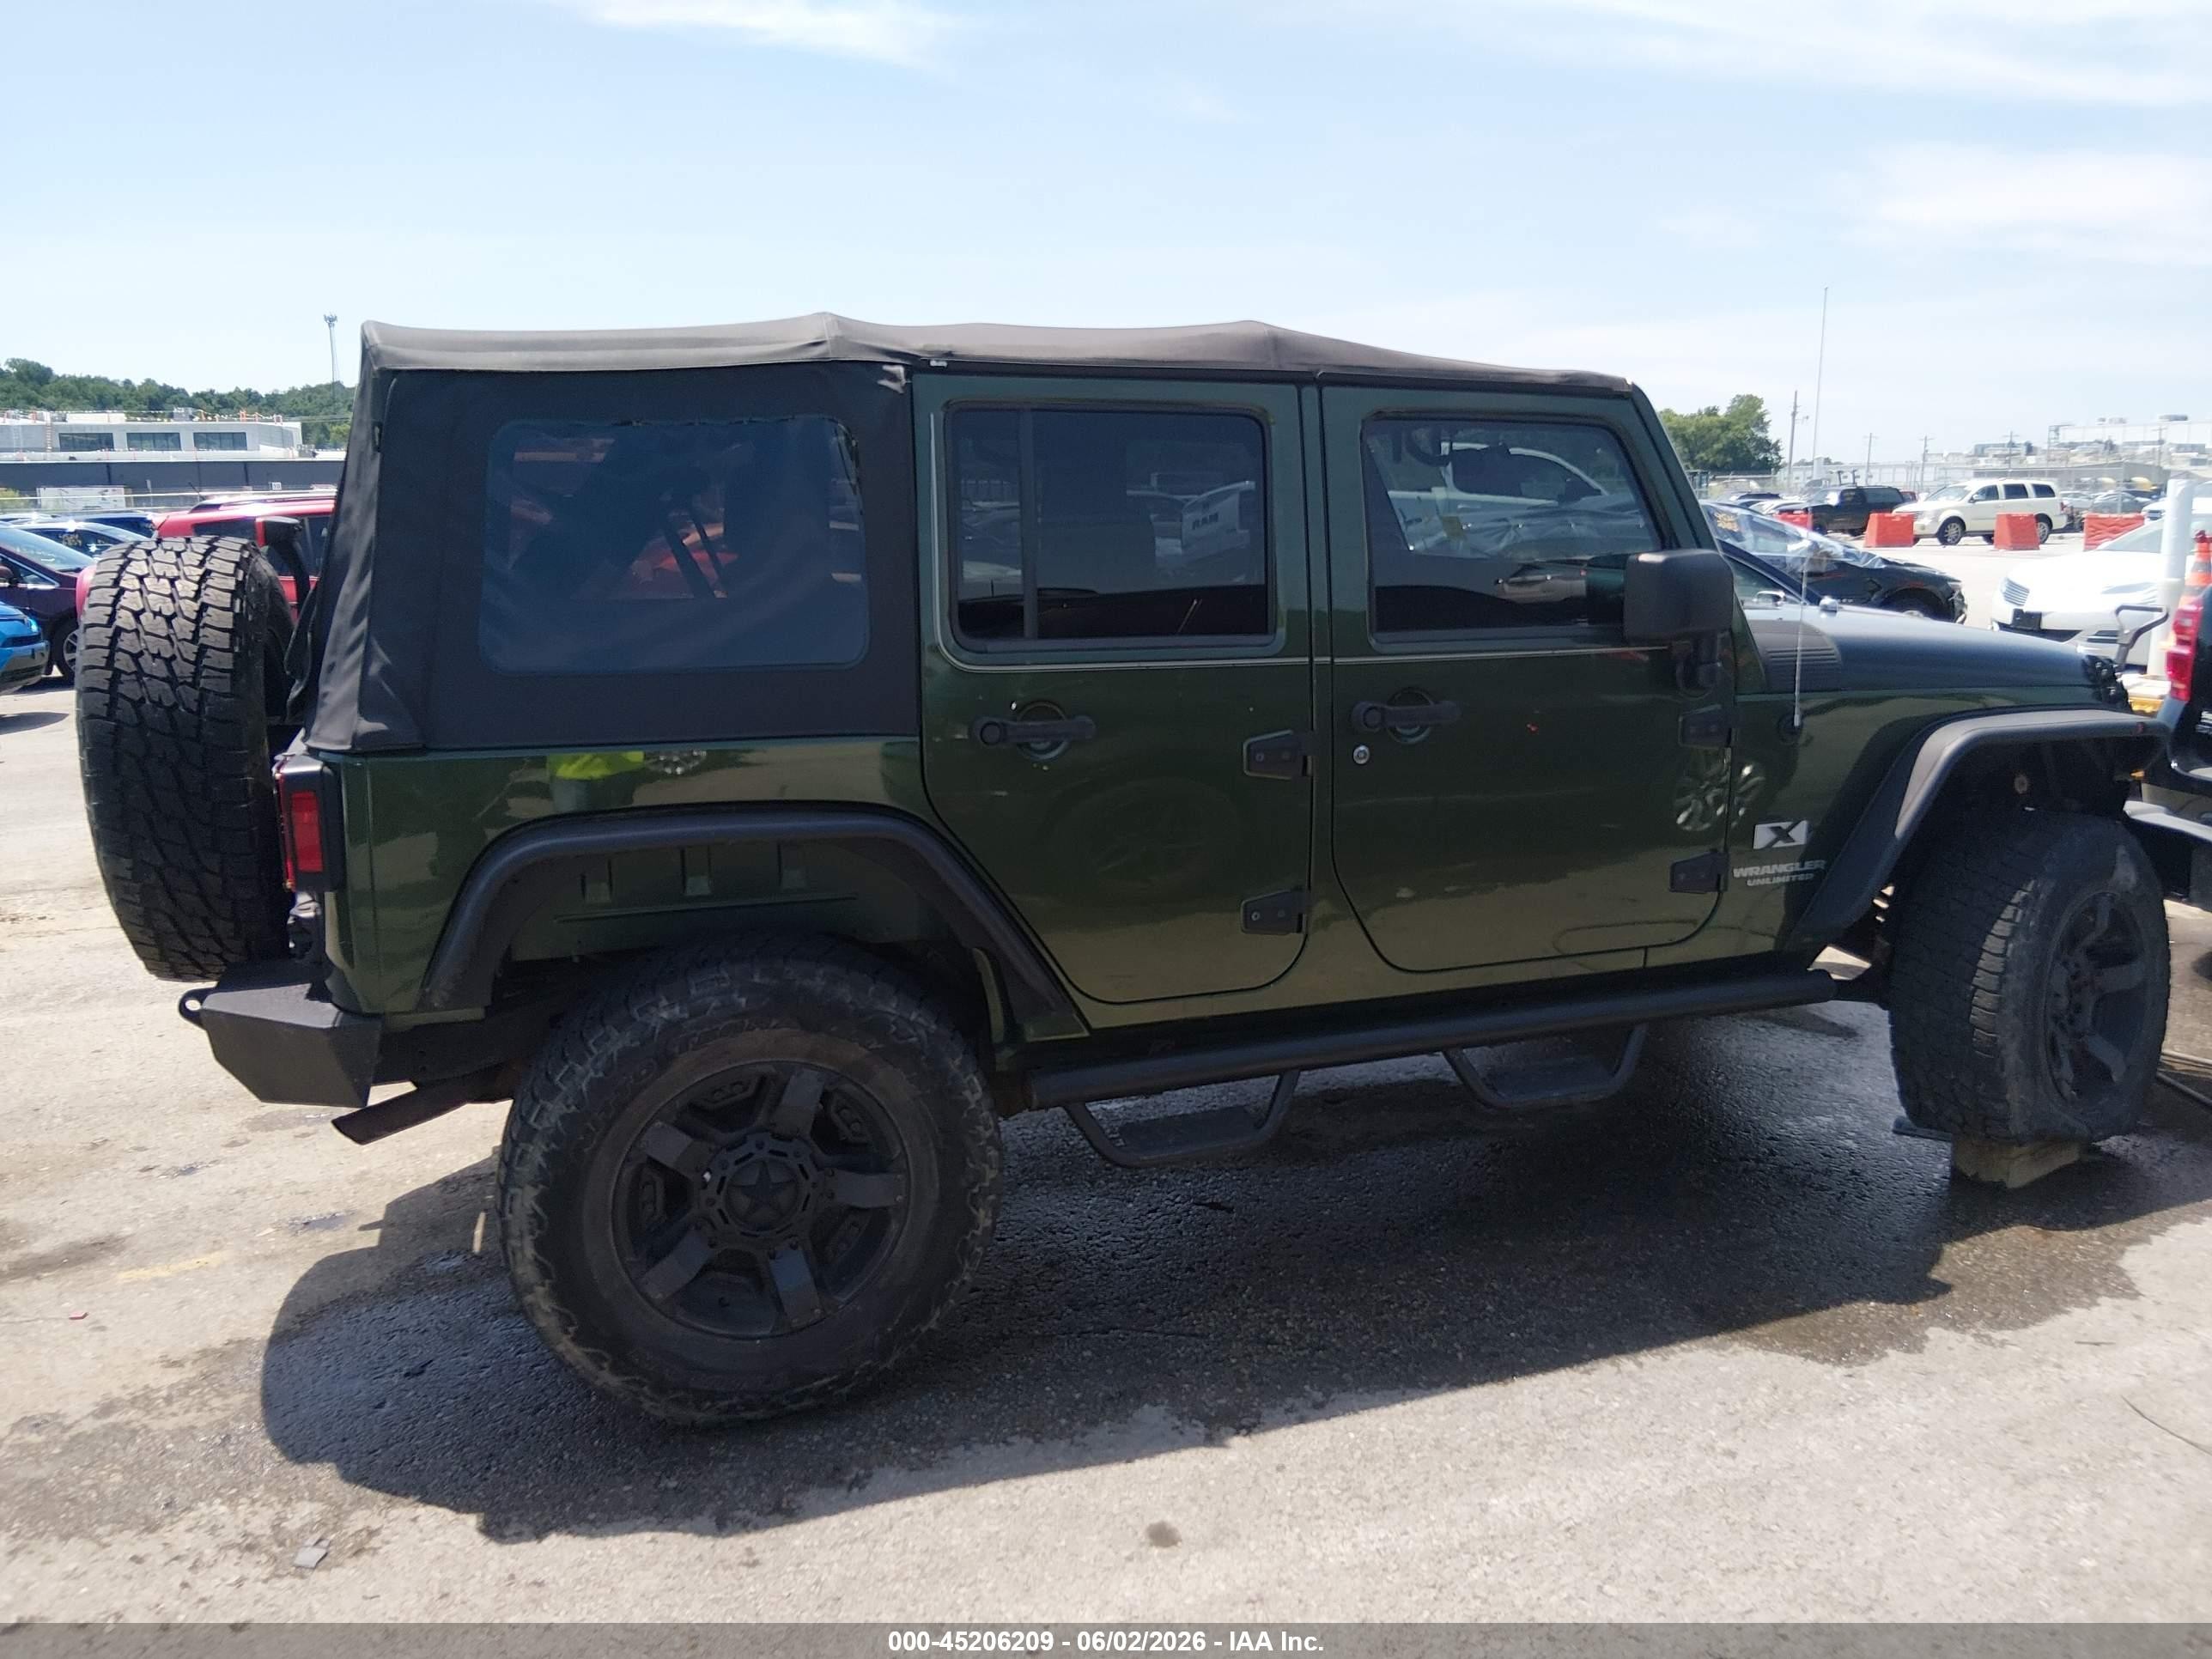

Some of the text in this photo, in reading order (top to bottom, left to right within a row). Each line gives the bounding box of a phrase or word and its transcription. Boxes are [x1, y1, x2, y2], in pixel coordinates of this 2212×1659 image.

[1759, 821, 1805, 849] X
[1733, 860, 1826, 878] WRANGLER
[1747, 872, 1814, 886] UNLIMITED
